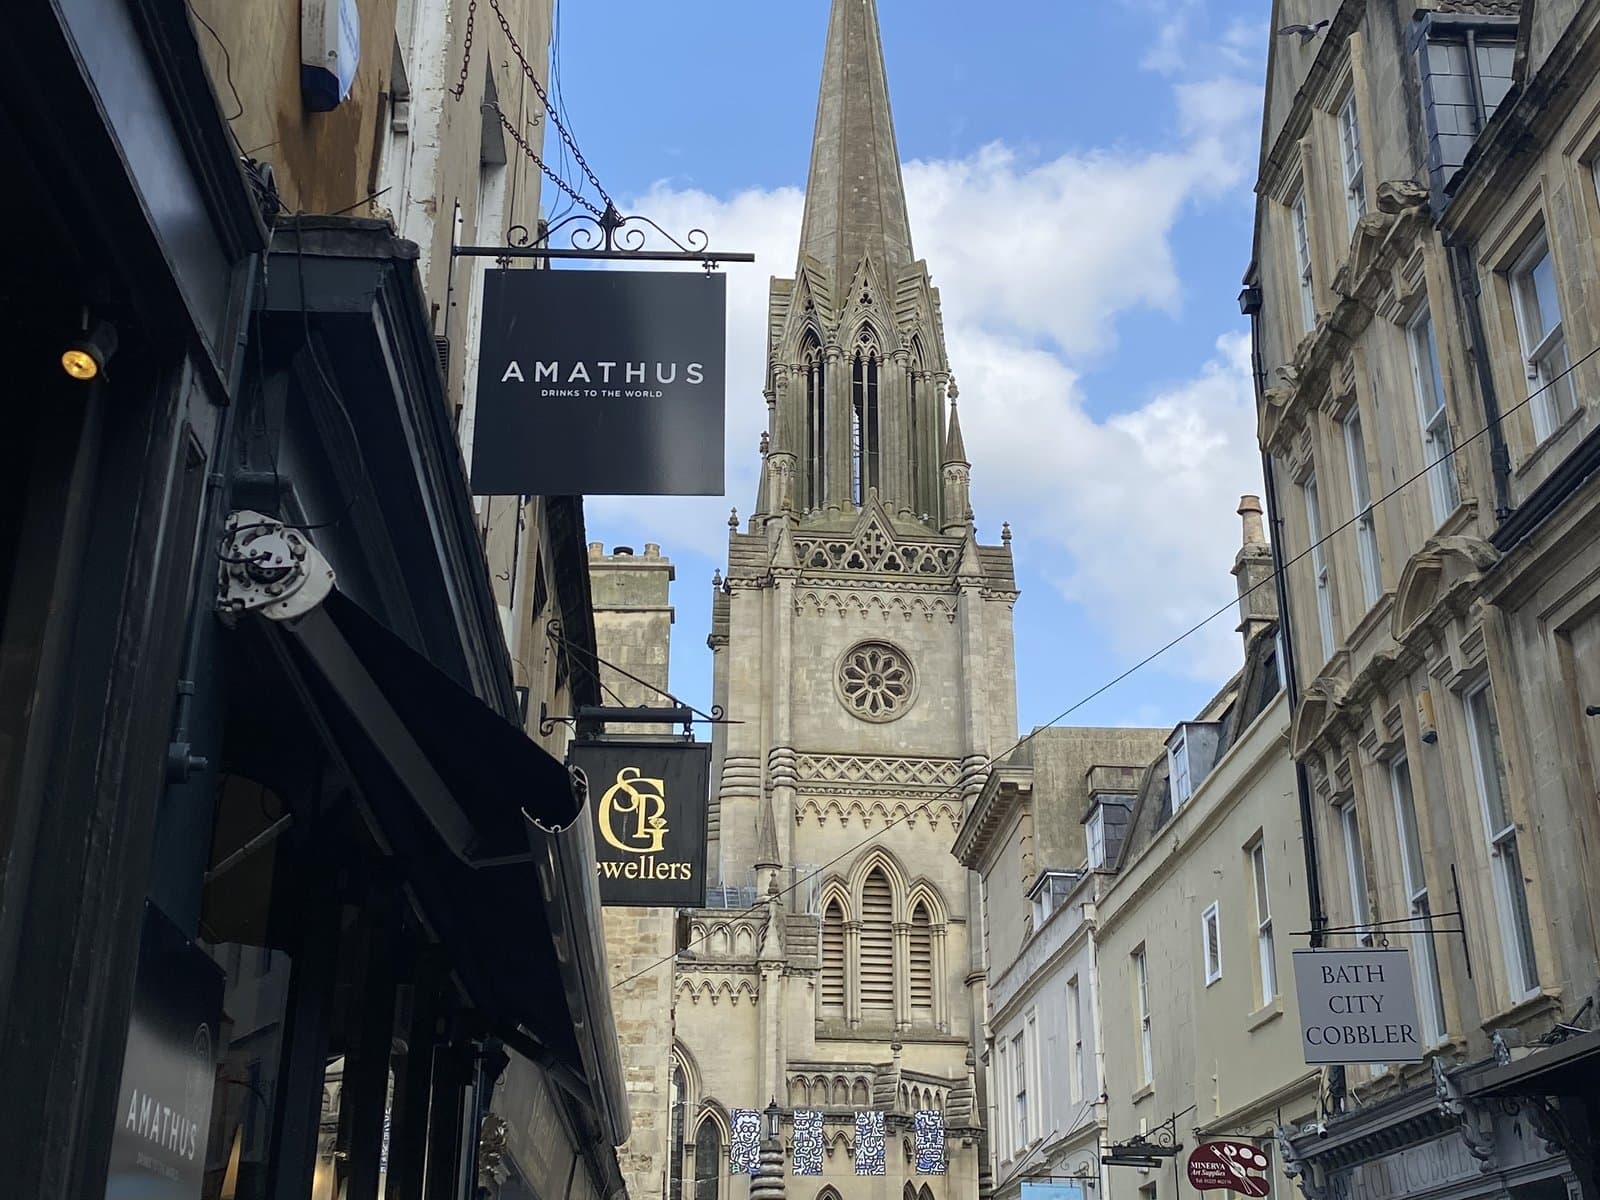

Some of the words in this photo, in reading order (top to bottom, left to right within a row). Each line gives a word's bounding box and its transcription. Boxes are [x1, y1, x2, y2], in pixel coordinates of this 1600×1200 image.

[501, 361, 704, 384] AMATHUS
[541, 389, 580, 397] DRINKS
[602, 390, 621, 398] THE
[625, 390, 663, 398] WORLD
[596, 855, 692, 880] wellers
[1321, 965, 1385, 984] BATH
[1328, 995, 1384, 1014] CITY
[1306, 1024, 1417, 1045] COBBLER
[126, 1089, 197, 1161] AMATHUS
[1190, 1161, 1225, 1170] MINERVA
